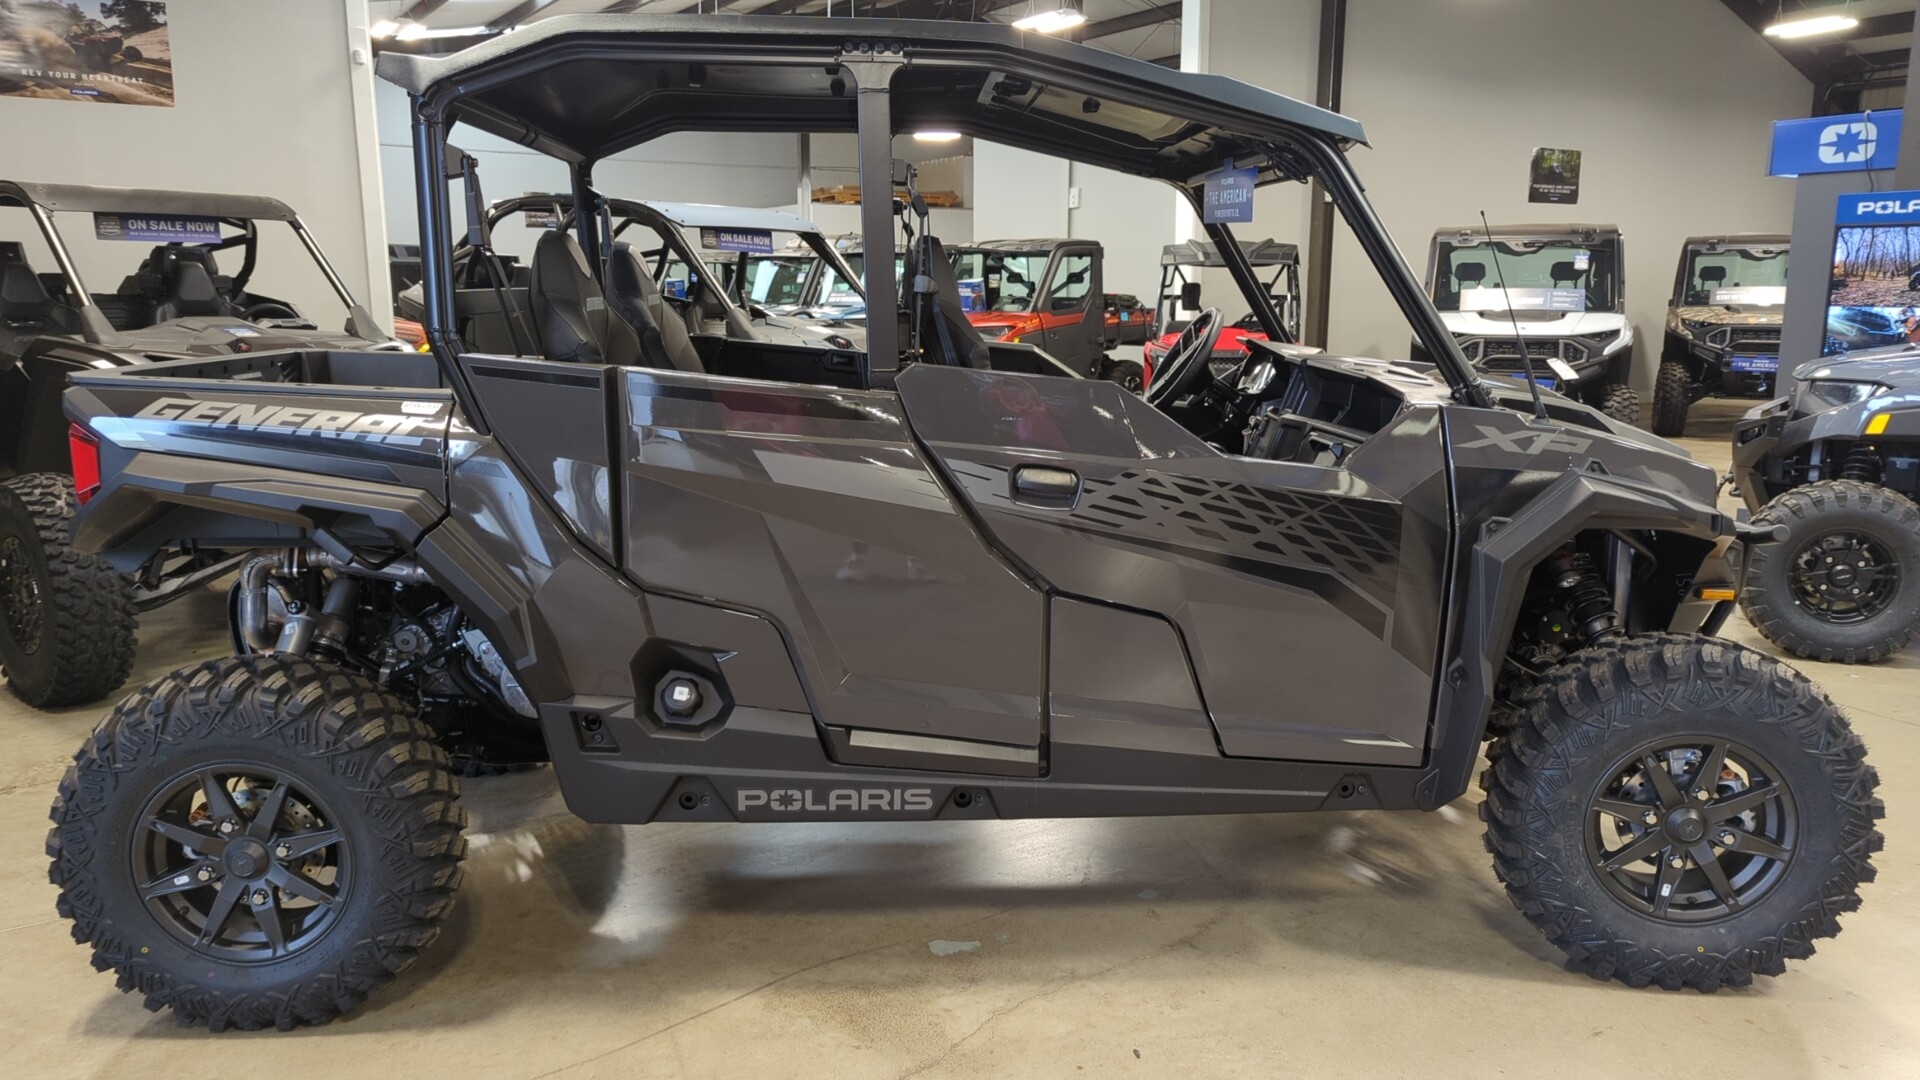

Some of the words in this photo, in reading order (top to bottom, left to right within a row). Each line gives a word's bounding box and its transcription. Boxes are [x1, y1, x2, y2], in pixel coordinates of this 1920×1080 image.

[21, 69, 42, 77] REV
[48, 71, 77, 79] YOUR
[81, 73, 143, 84] HEARTBEAT
[1209, 191, 1219, 205] THE
[1220, 188, 1247, 204] AMERICAN
[128, 219, 147, 230] ON
[149, 220, 184, 231] SALE
[186, 222, 215, 232] NOW
[720, 233, 732, 242] ON
[732, 234, 753, 244] SALE
[753, 236, 770, 246] NOW
[133, 397, 429, 446] GENERAL
[1455, 425, 1593, 454] XP
[737, 788, 934, 811] POLARIS
